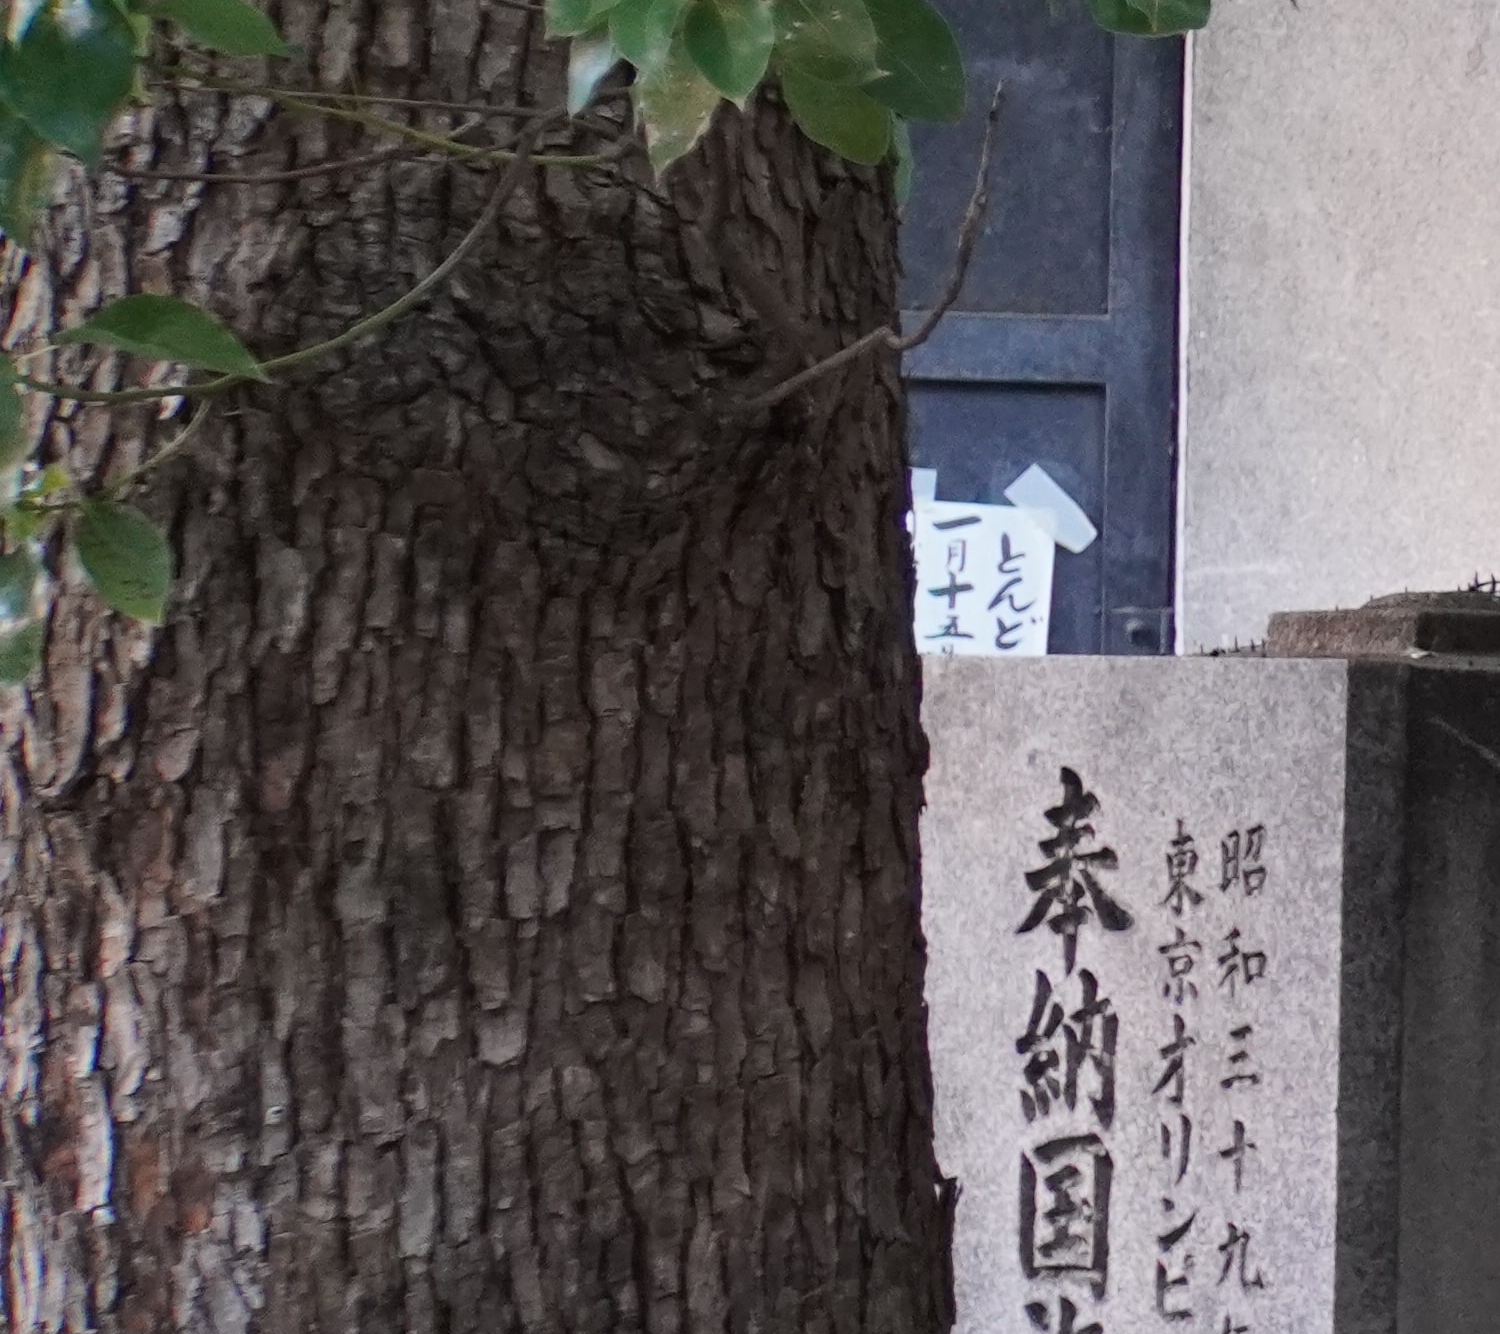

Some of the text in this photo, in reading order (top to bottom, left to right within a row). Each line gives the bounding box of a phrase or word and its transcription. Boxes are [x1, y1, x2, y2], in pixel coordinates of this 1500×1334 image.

[924, 516, 982, 655] 一月十五
[987, 532, 1044, 650] とんど
